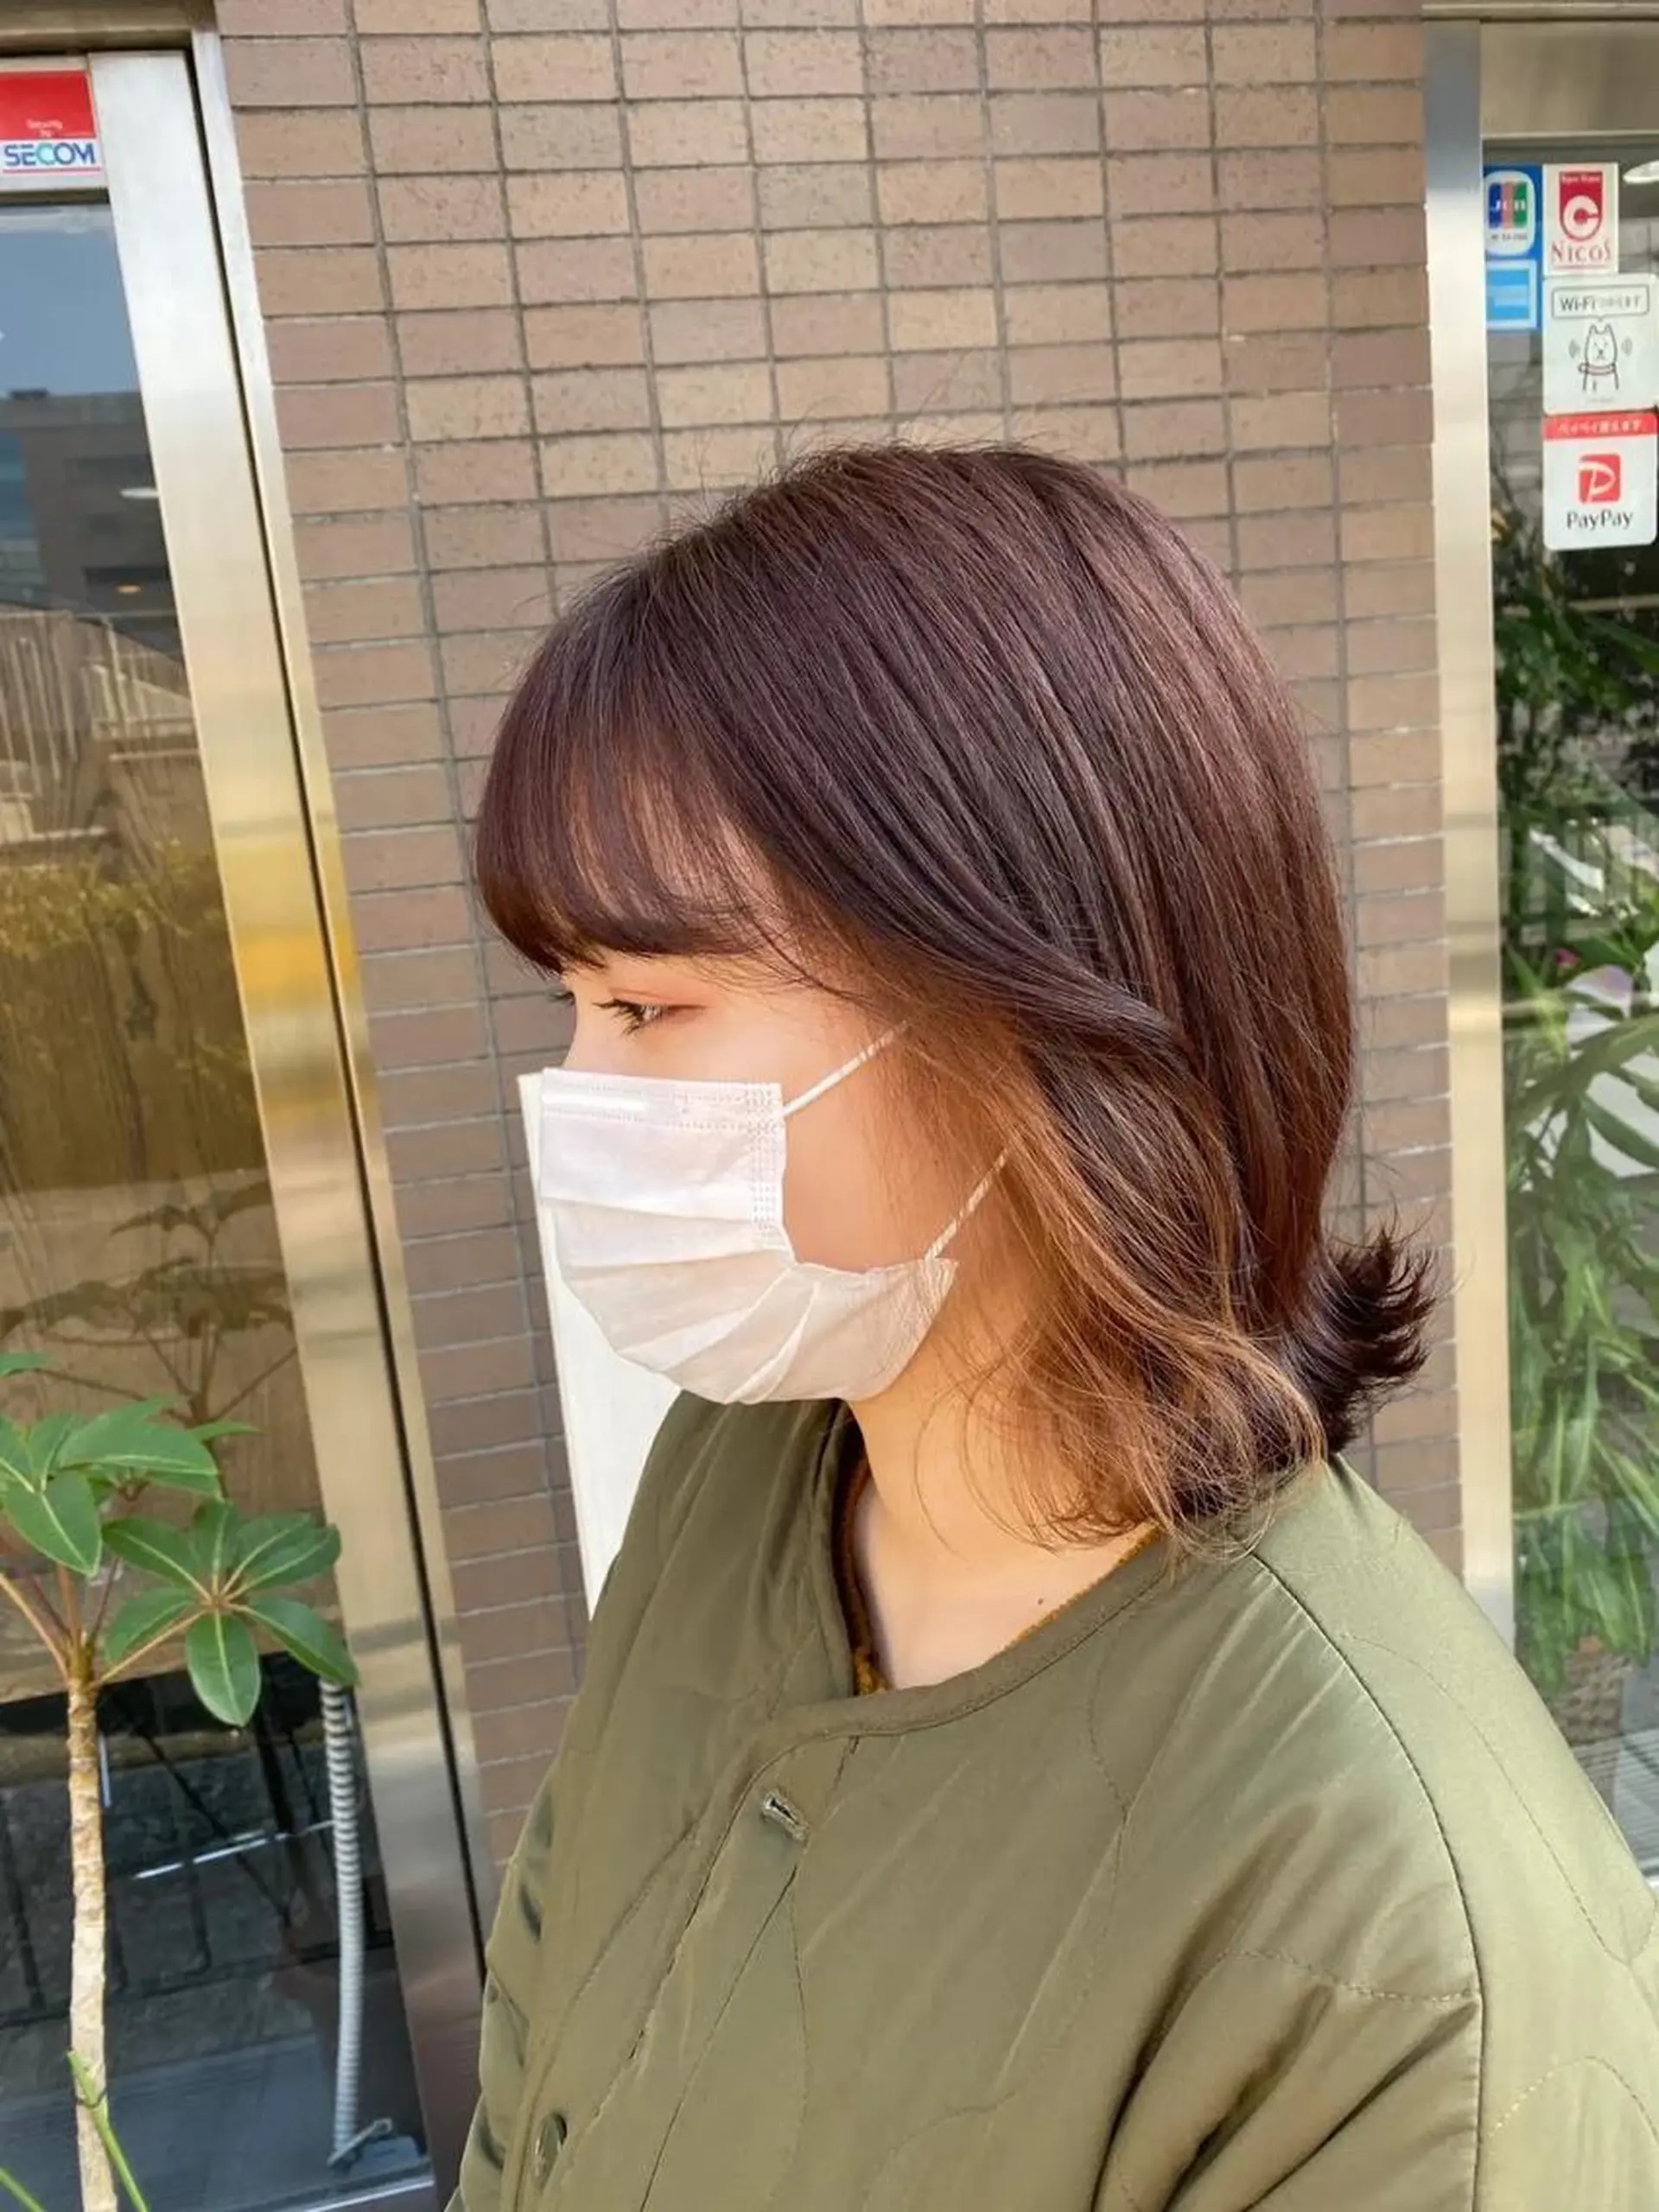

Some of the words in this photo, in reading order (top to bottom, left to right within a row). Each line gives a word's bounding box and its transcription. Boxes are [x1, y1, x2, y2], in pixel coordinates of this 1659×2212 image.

[3, 142, 96, 166] SECOM
[1552, 238, 1612, 264] NICOS
[1560, 295, 1596, 312] Wi-Fi
[1567, 509, 1634, 531] PayPay
